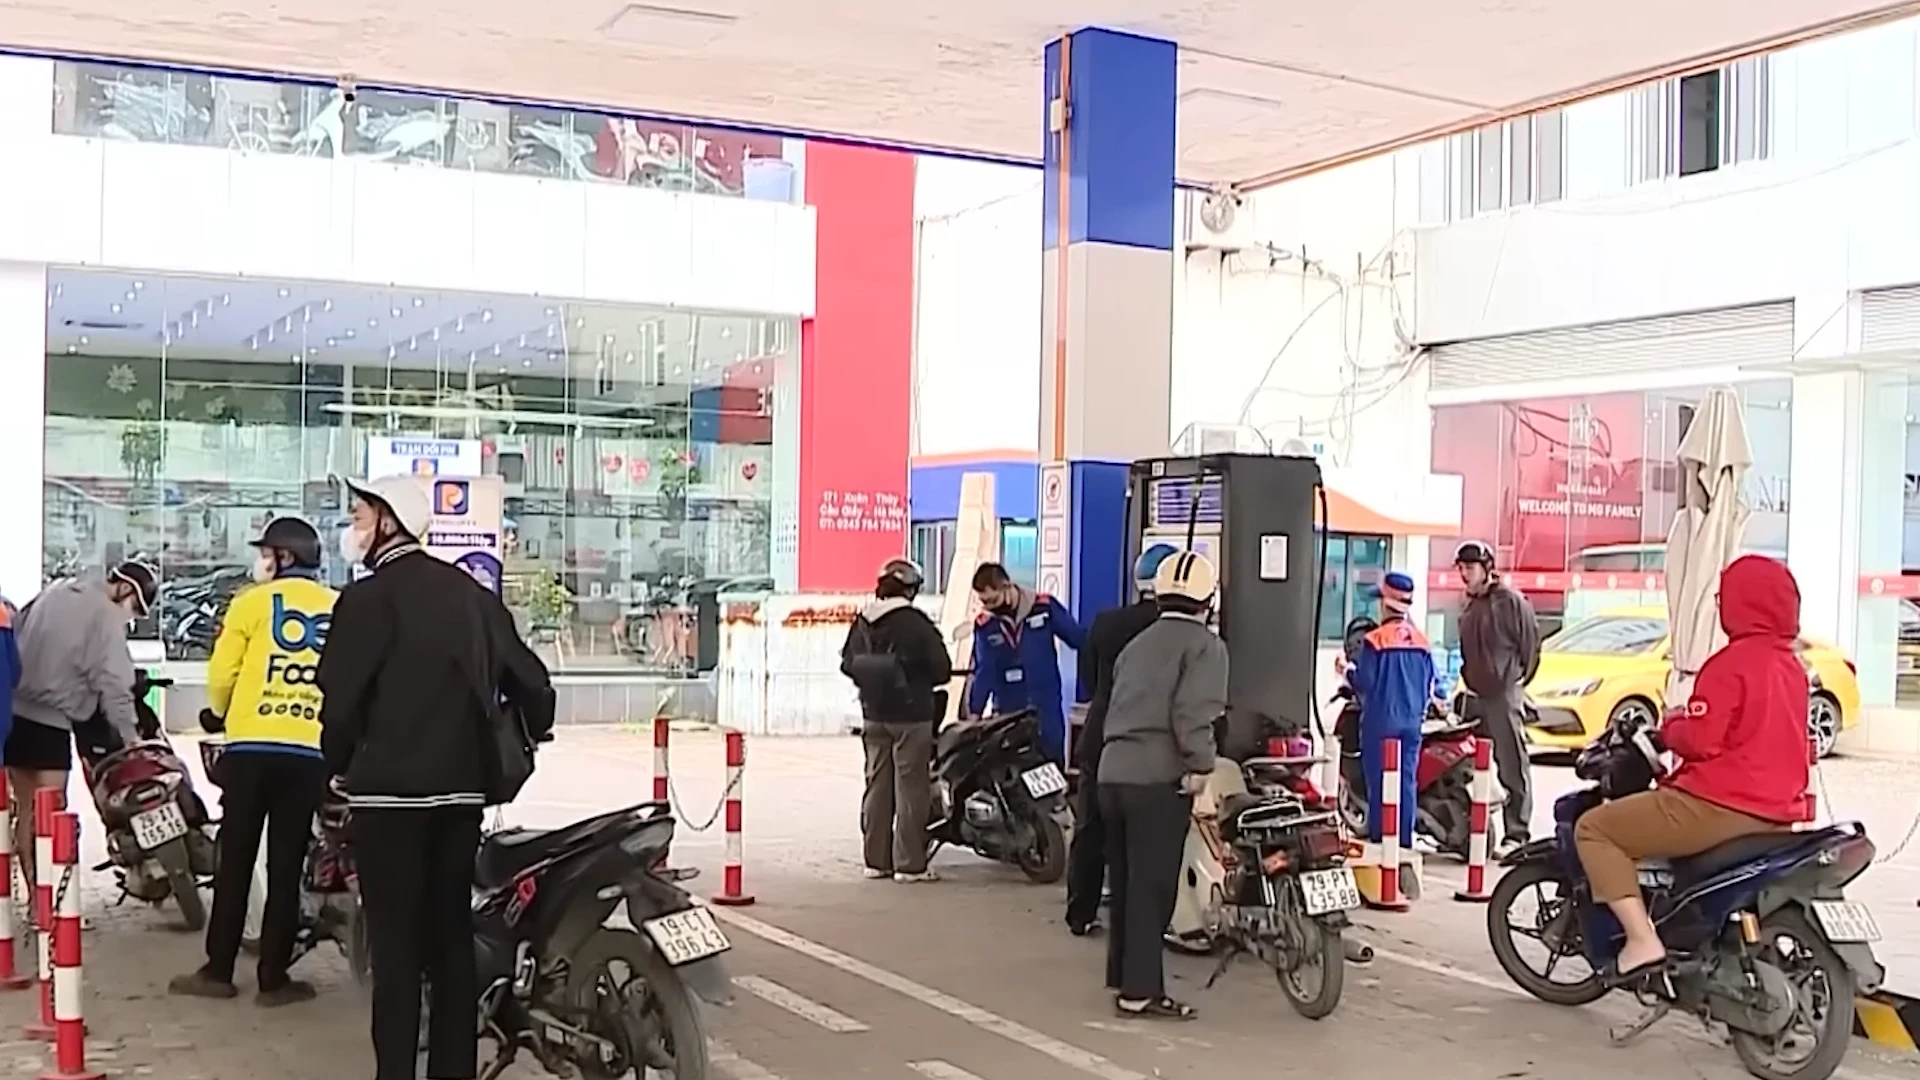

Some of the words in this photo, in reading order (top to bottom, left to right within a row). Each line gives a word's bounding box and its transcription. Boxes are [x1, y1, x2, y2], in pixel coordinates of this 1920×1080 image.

[1519, 498, 1570, 516] WELCOME
[1573, 502, 1586, 516] TO
[1605, 504, 1641, 518] FAMILY
[267, 654, 319, 685] Foo
